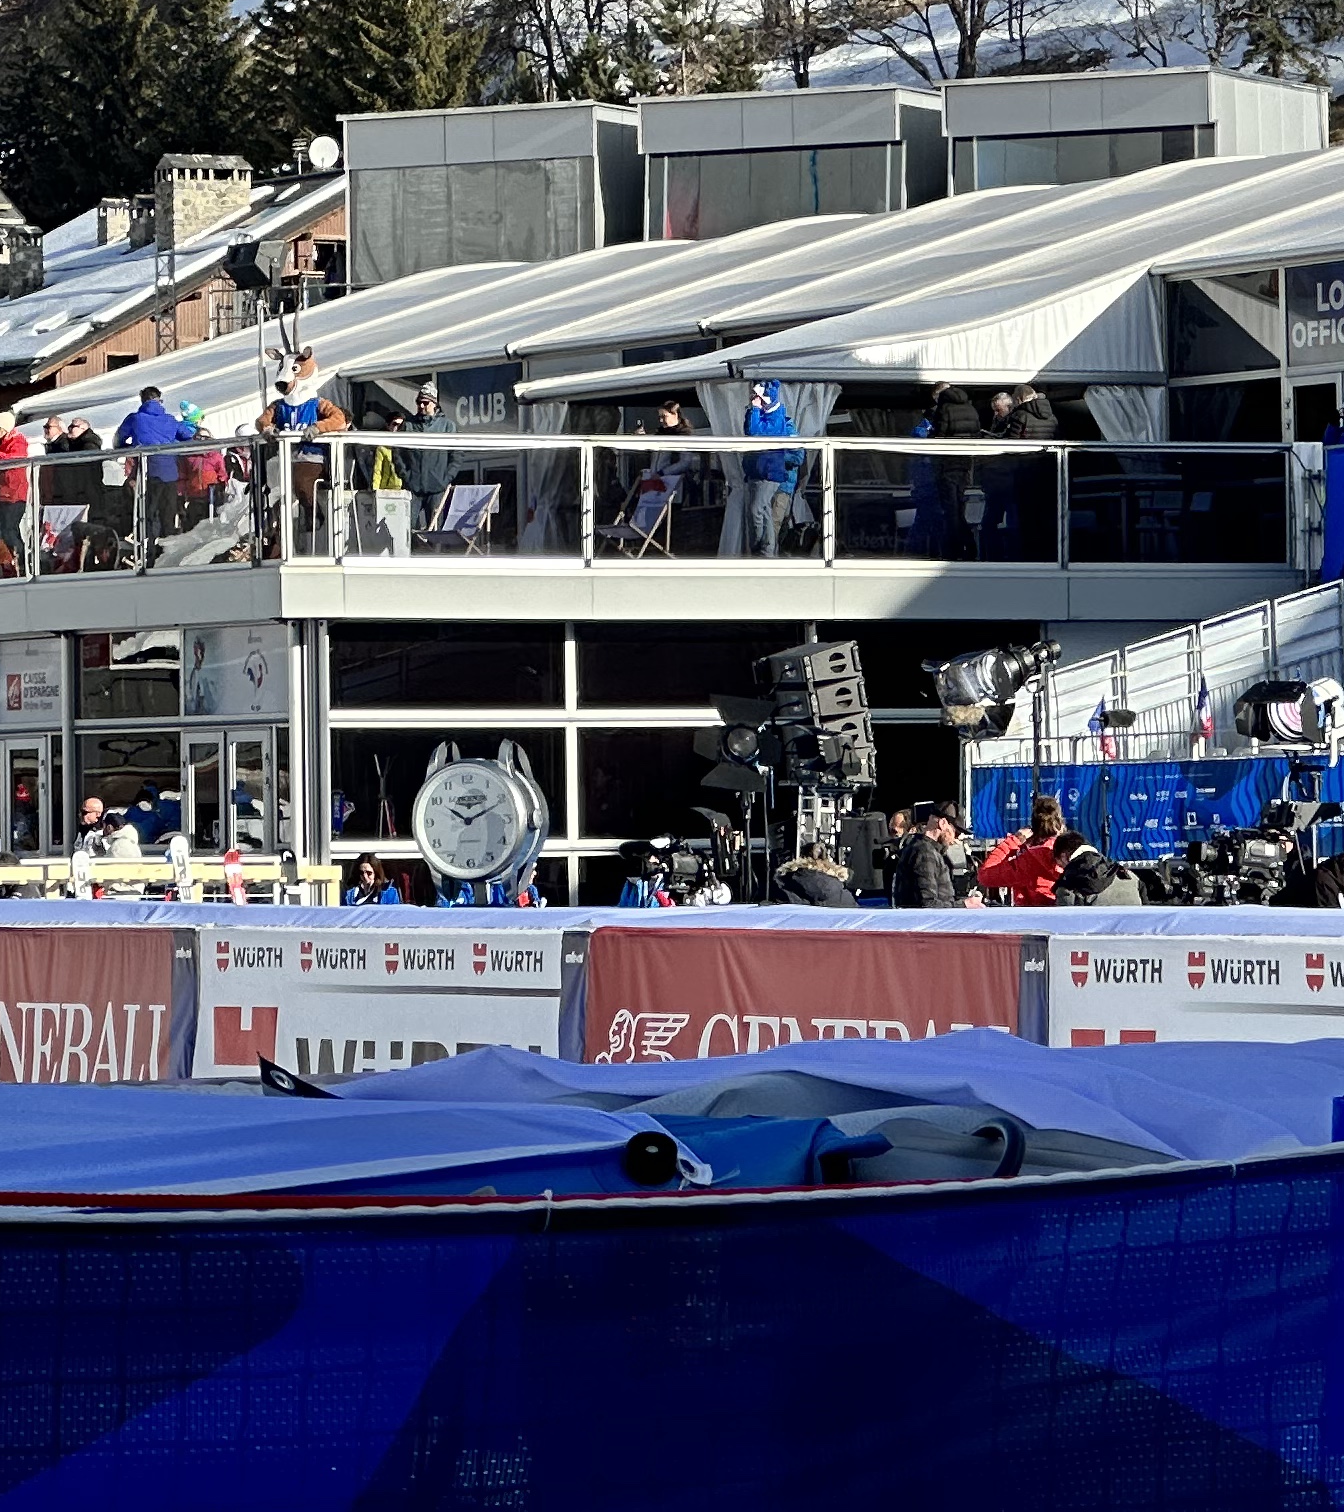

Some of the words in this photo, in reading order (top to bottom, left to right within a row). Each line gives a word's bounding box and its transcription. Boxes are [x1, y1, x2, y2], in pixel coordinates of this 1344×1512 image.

[456, 392, 506, 426] CLUB
[233, 947, 283, 968] WÜRTH
[316, 948, 367, 970] WÜRTH
[403, 948, 455, 971] WÜRTH
[490, 950, 543, 973] WÜRTH
[1094, 958, 1163, 984] WÜRTH
[1211, 958, 1280, 986] WÜRTH
